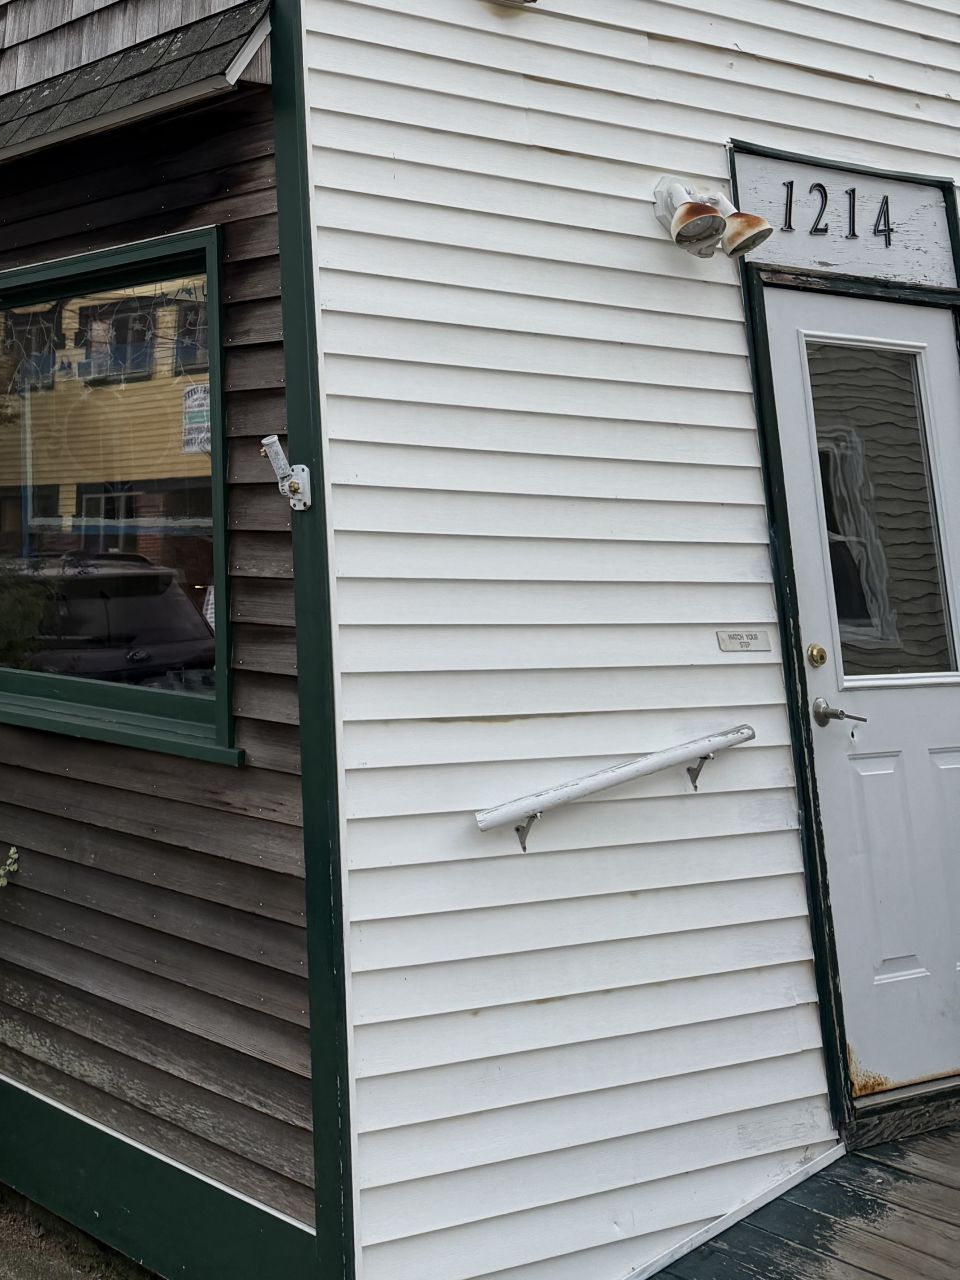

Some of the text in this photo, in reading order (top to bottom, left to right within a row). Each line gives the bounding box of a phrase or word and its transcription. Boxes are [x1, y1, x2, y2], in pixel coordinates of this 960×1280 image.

[780, 180, 894, 249] 1214
[727, 633, 759, 641] WATCH YOUR
